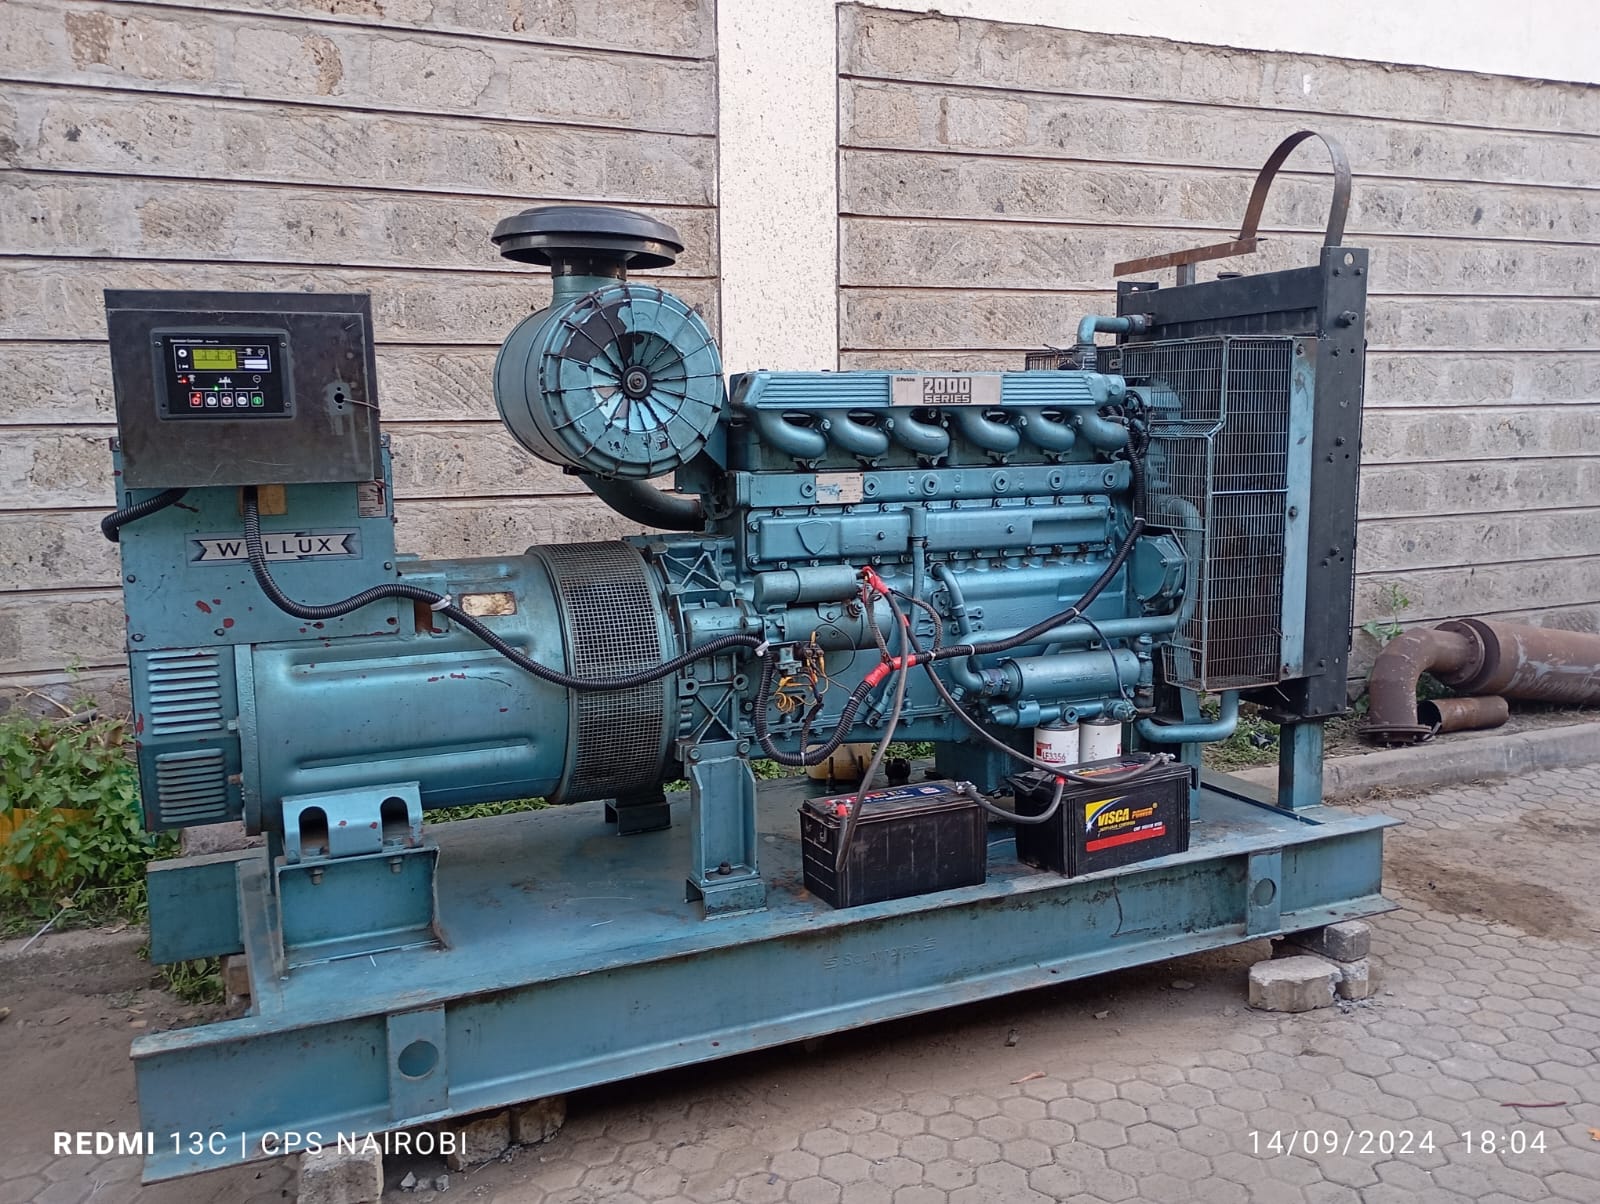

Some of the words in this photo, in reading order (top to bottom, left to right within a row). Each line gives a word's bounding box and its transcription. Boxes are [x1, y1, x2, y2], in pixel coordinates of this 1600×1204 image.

[924, 378, 970, 393] 2000
[924, 394, 970, 404] SERIES
[217, 538, 332, 557] WLLUX
[1042, 752, 1066, 761] LF3356
[1098, 808, 1130, 826] VISCA
